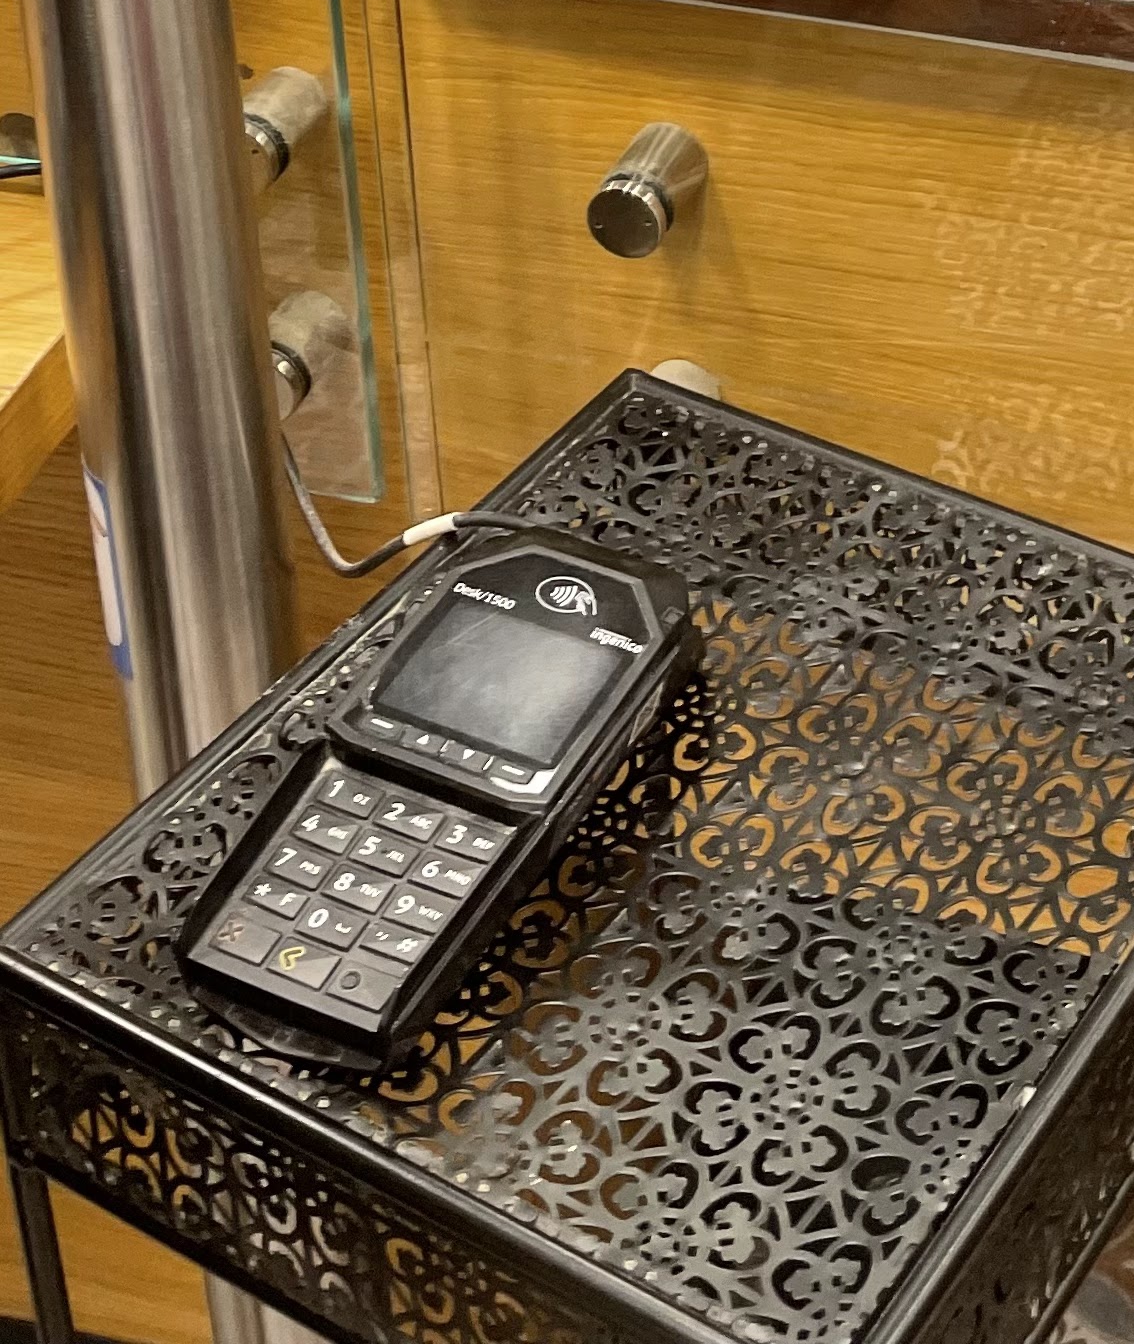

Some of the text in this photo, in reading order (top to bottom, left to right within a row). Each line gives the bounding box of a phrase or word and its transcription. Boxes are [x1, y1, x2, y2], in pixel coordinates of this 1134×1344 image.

[453, 582, 516, 610] Desk/1500
[589, 627, 644, 654] ingenico
[327, 779, 345, 797] 1
[382, 803, 406, 822] 2
[301, 814, 321, 832] 4
[445, 824, 468, 845] 3
[358, 836, 382, 856] 5
[274, 847, 298, 867] 7
[421, 861, 443, 878] 6
[333, 873, 356, 892] 8
[394, 895, 416, 915] 9
[307, 909, 330, 928] 0
